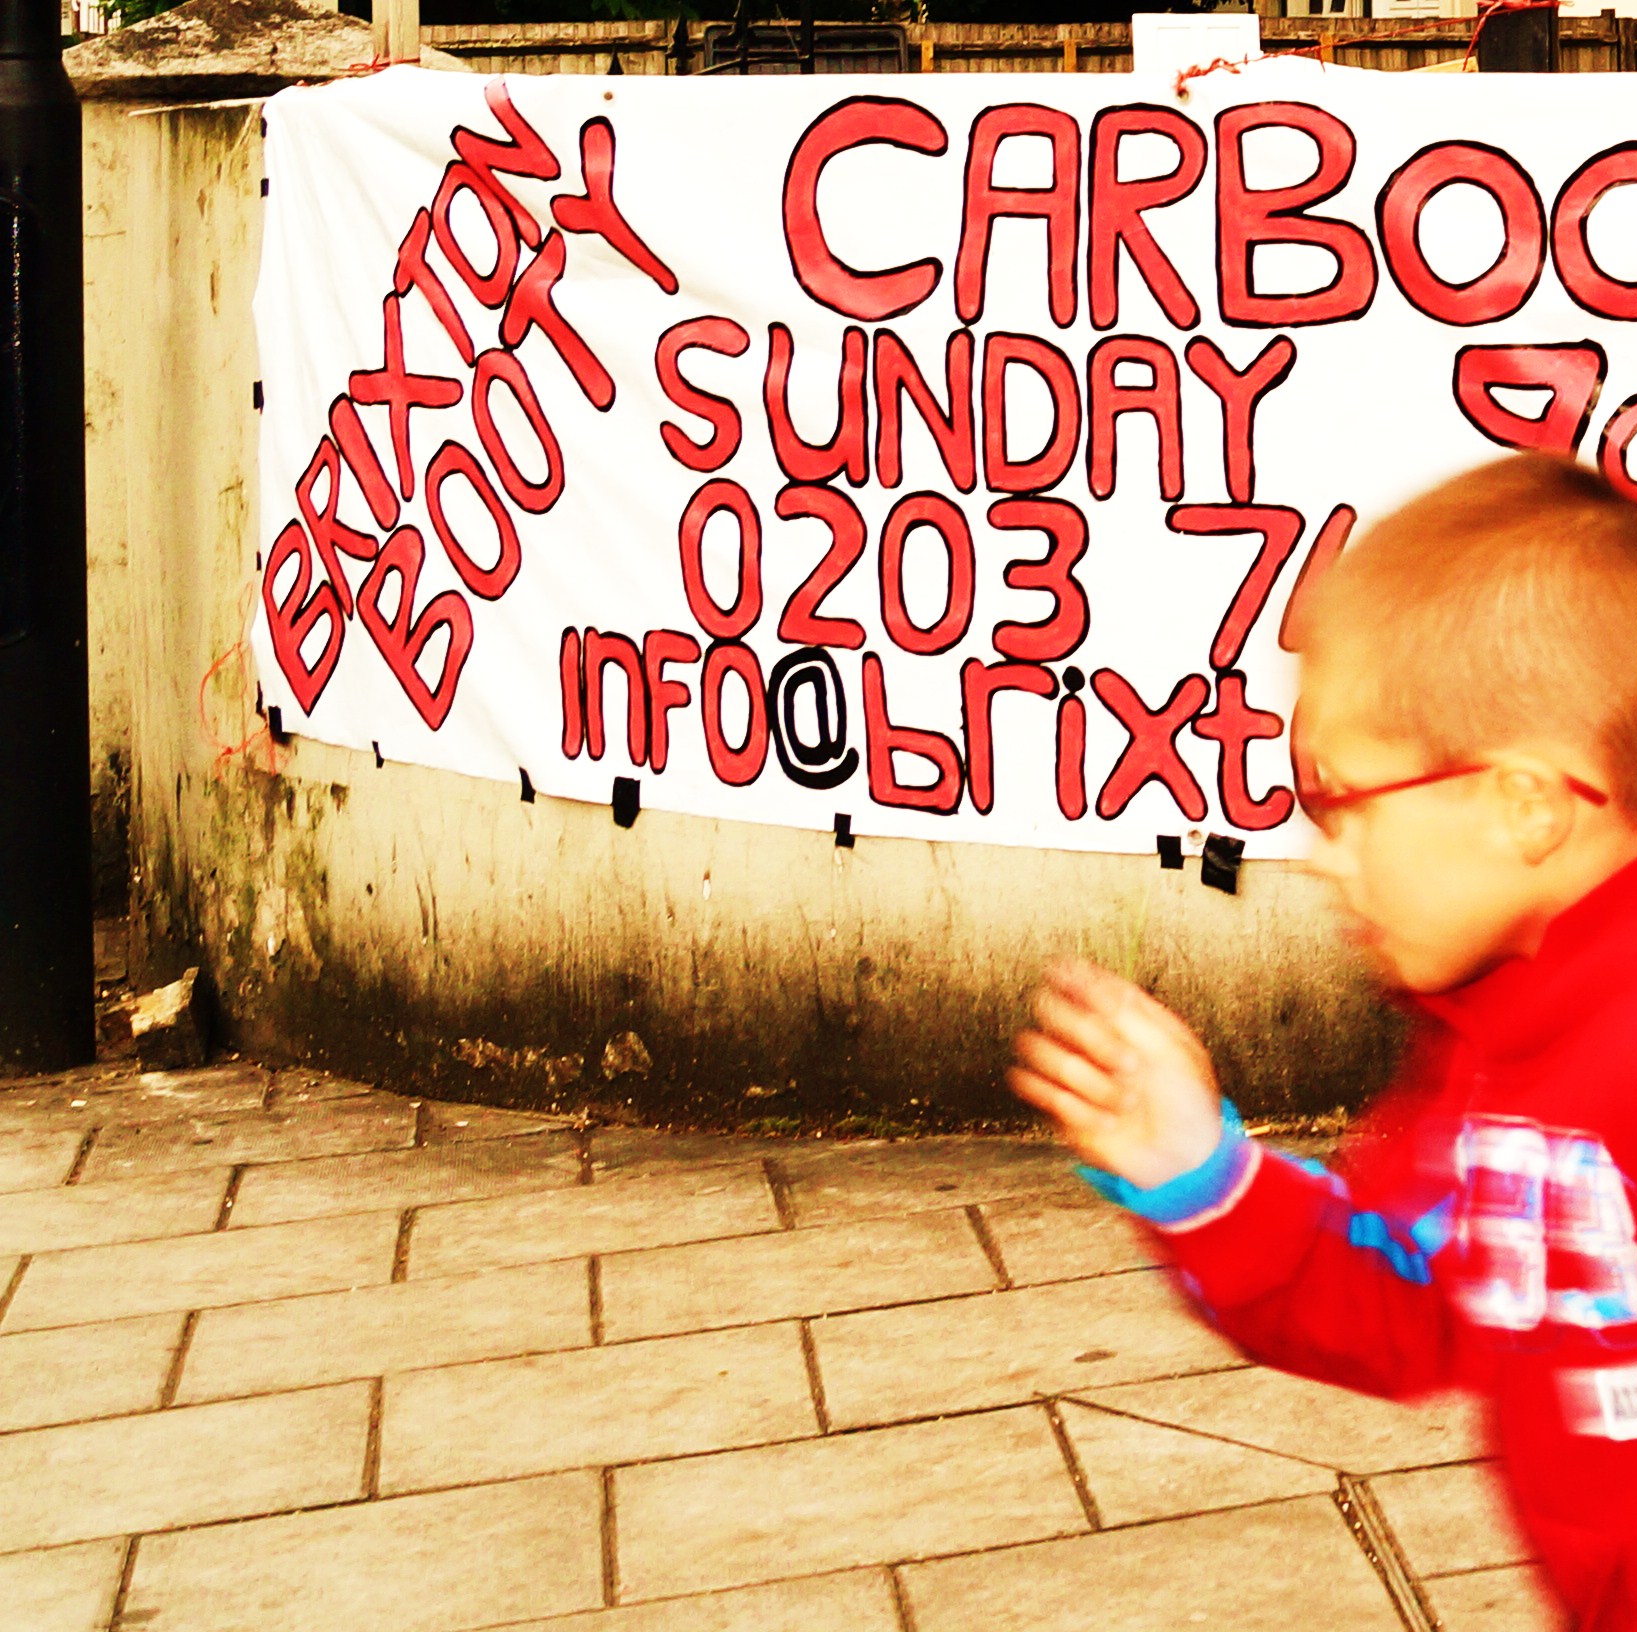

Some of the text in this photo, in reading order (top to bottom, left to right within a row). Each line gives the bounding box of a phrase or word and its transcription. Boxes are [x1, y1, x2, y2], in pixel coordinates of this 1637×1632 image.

[260, 76, 562, 718] BRIXTON
[354, 115, 680, 731] BOOTY
[654, 313, 1297, 506] SUNDAY
[678, 476, 1090, 662] 0203
